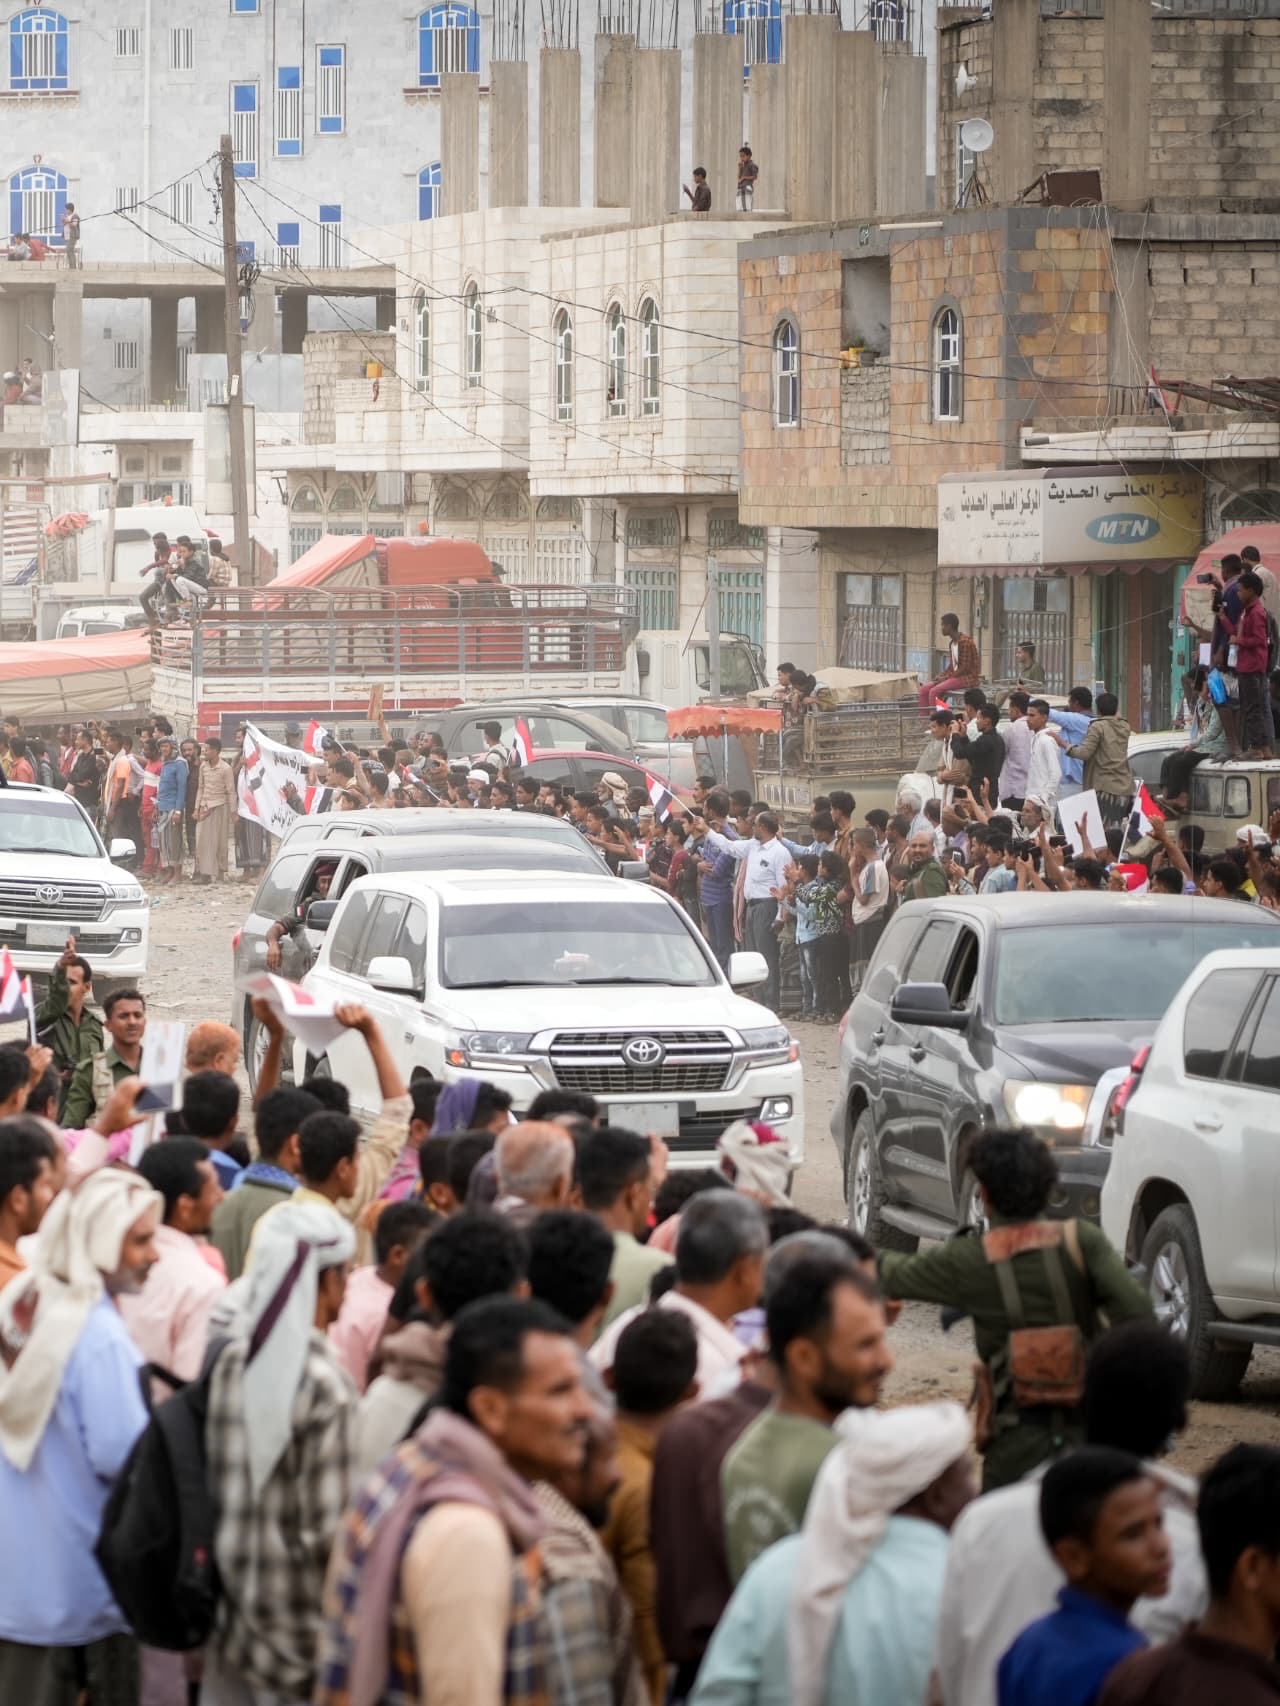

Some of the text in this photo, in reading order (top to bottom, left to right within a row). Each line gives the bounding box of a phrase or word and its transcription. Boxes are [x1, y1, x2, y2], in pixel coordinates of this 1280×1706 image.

[960, 485, 1041, 520] المركز العالمي الحديث
[1048, 482, 1099, 503] الحديث
[1103, 483, 1155, 503] العالمي
[1096, 519, 1149, 538] MTN
